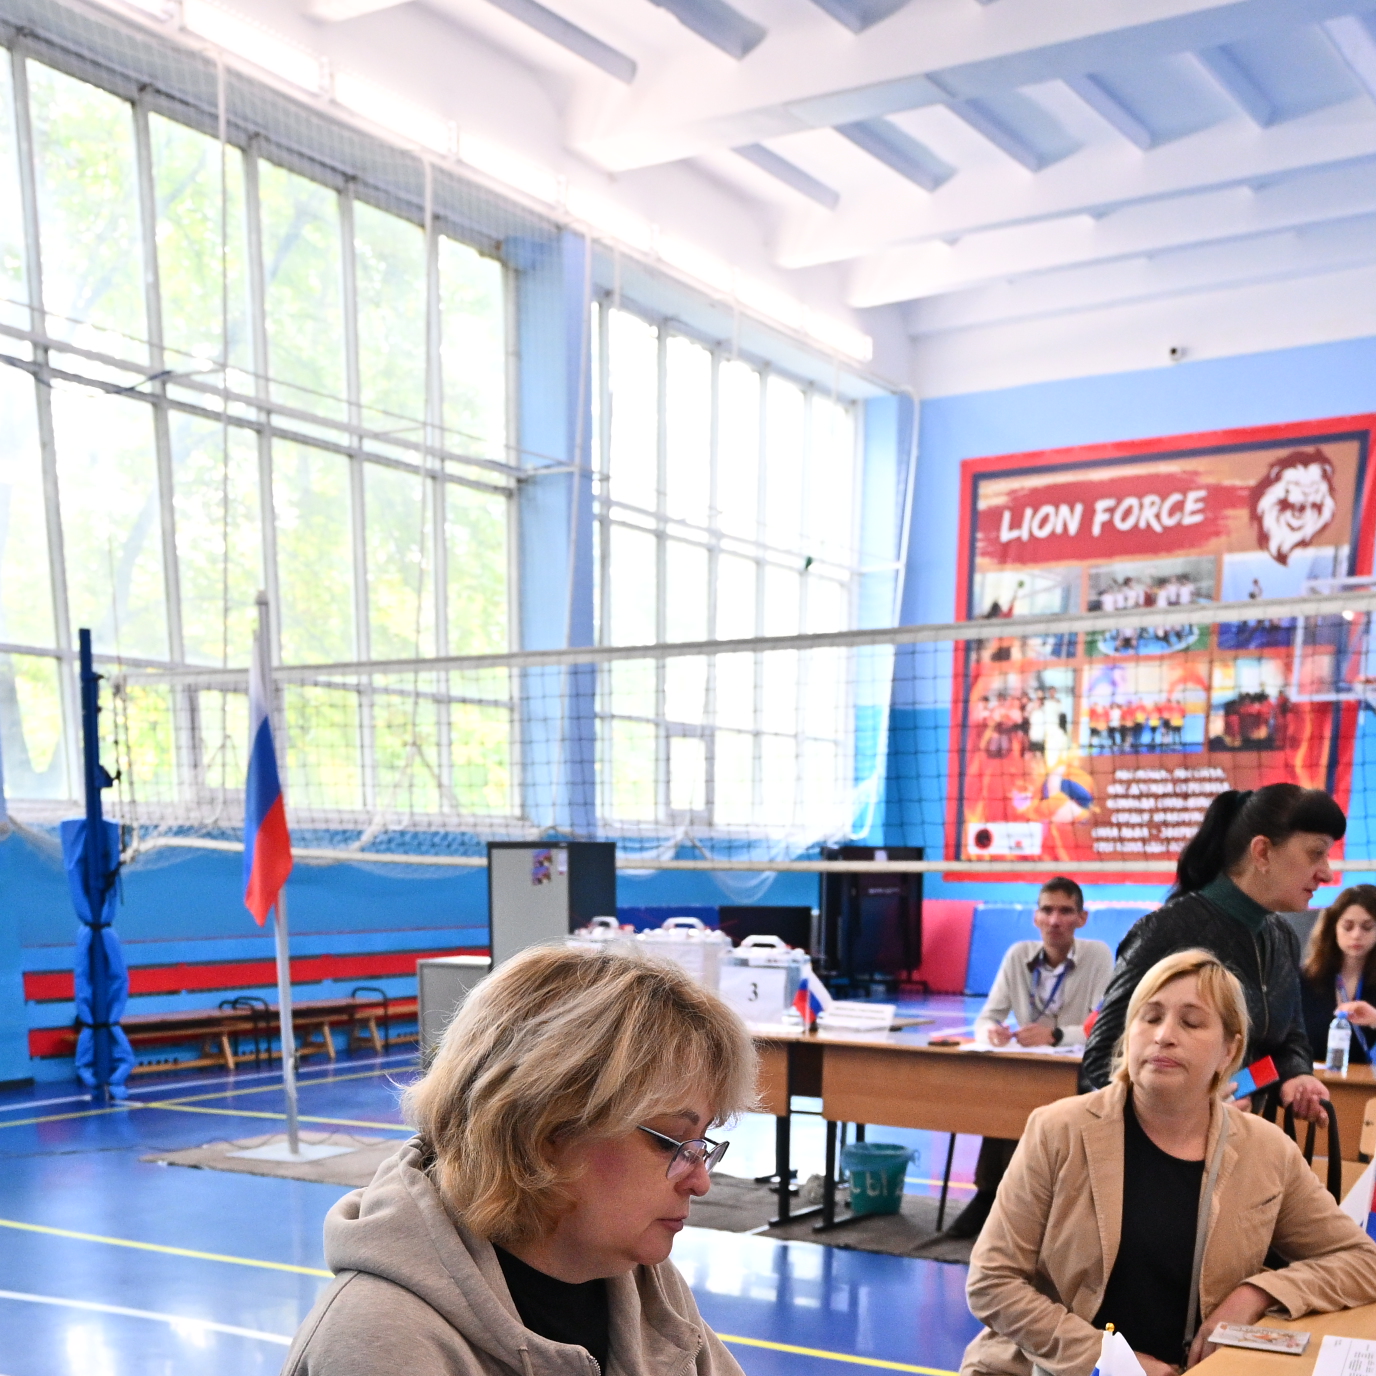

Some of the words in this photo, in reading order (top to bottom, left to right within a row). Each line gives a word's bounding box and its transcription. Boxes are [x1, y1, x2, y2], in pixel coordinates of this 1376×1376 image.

[999, 502, 1084, 543] LION
[1091, 489, 1208, 538] FORCE
[748, 982, 759, 1002] 3
